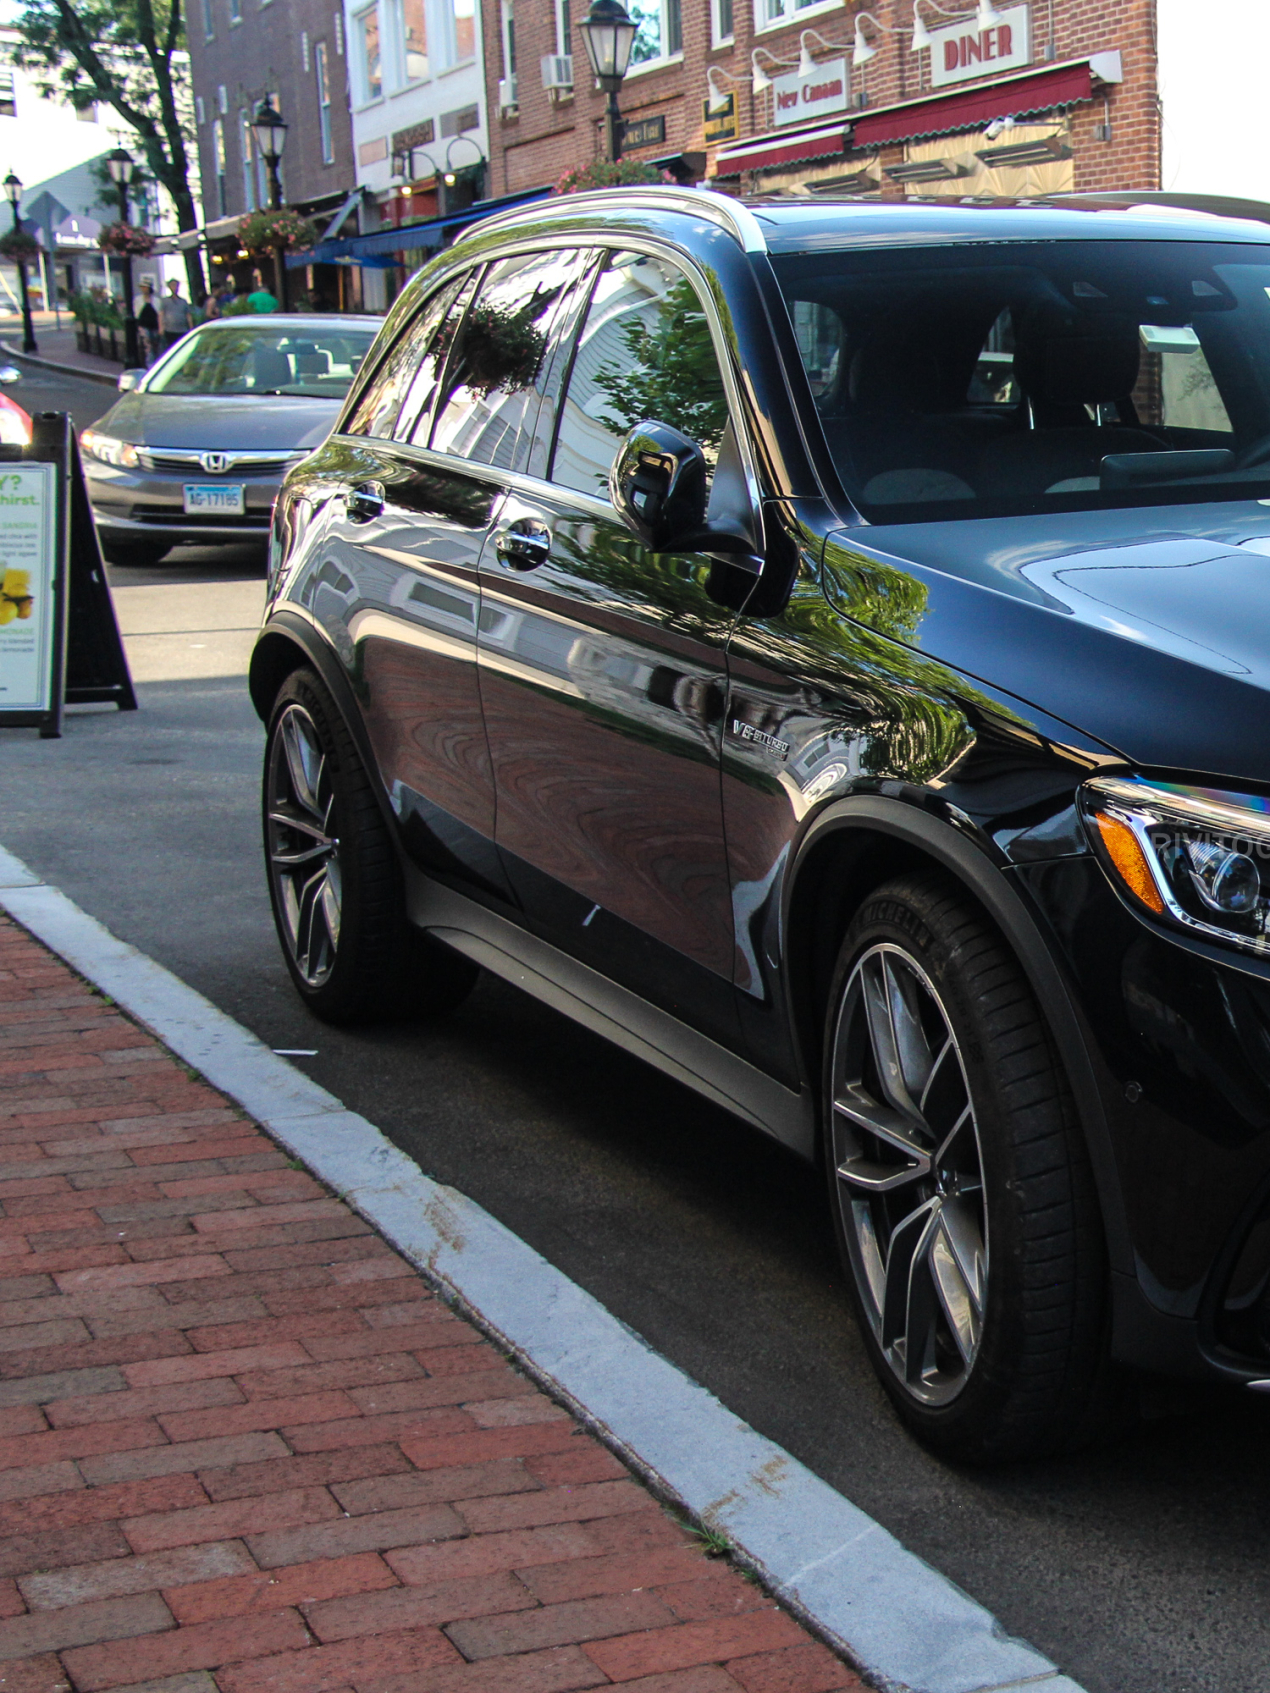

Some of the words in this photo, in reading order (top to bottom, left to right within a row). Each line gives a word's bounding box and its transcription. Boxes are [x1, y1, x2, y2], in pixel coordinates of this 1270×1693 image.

[944, 24, 1012, 71] DINER
[777, 91, 798, 110] New
[802, 79, 843, 104] Canaan
